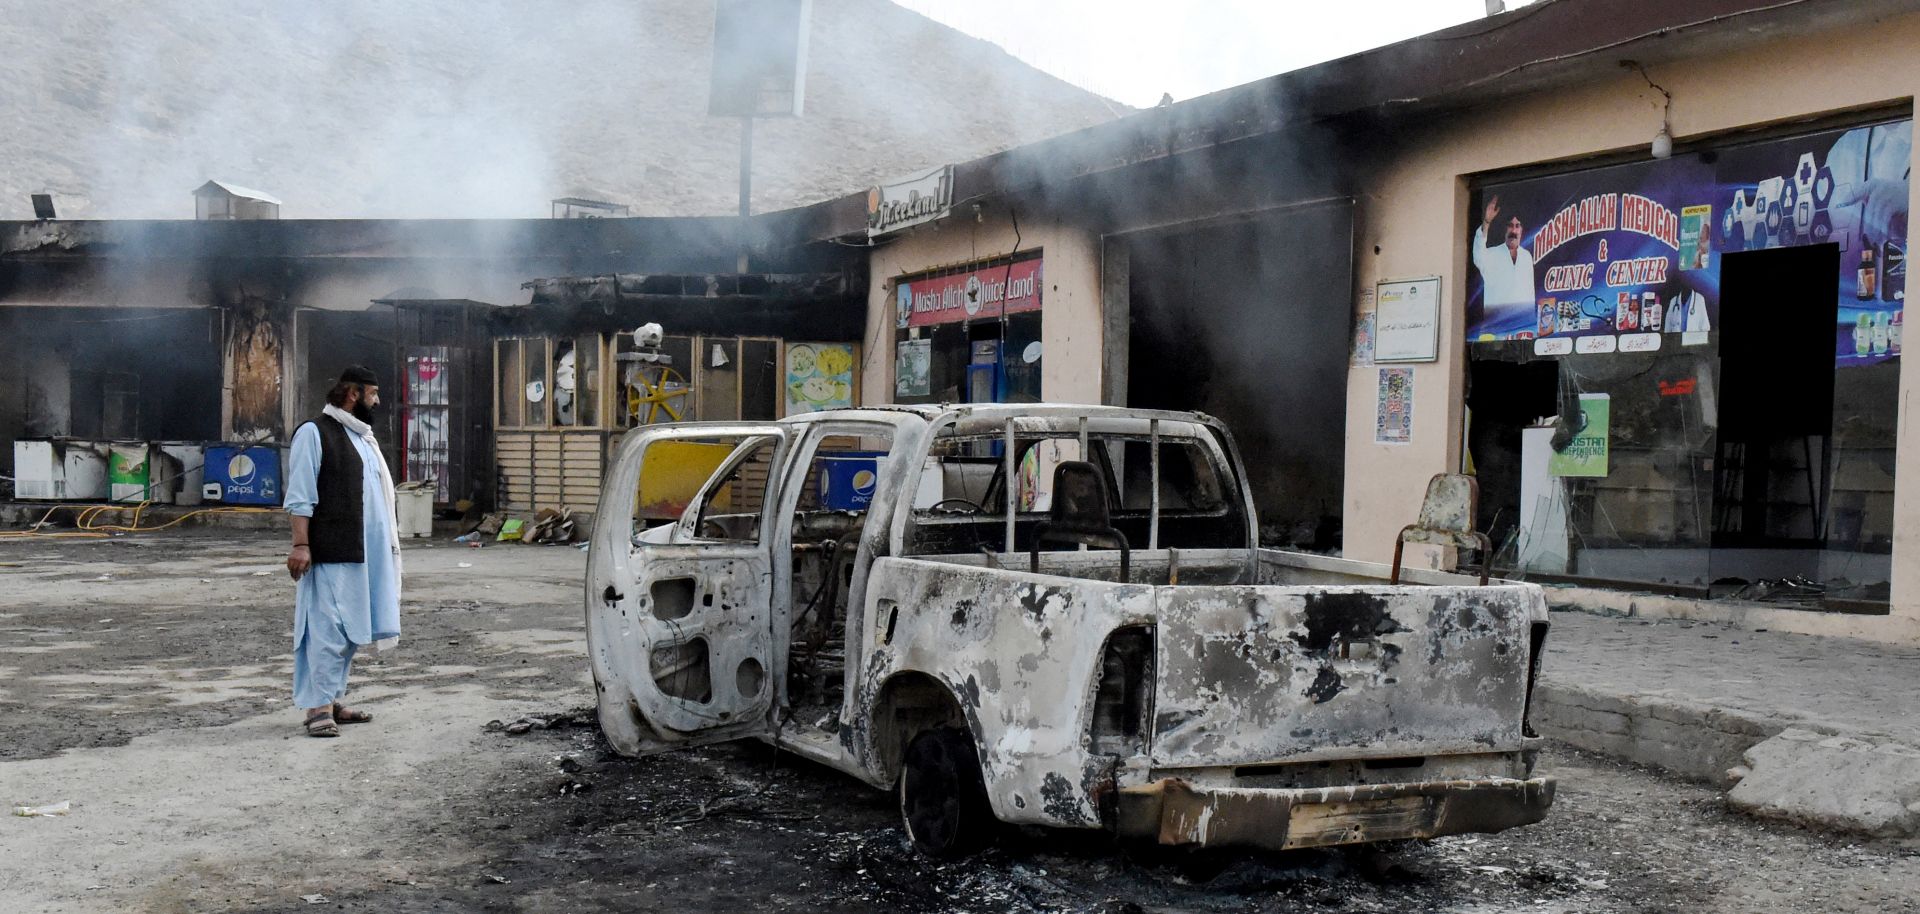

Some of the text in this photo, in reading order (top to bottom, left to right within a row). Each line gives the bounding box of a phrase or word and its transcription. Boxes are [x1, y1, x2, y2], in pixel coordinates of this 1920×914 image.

[1534, 193, 1679, 265] MASHA ALLAH MEDICAL
[1597, 238, 1608, 262] &
[914, 271, 1034, 312] Masha Allah Juice Land
[1545, 257, 1668, 292] CLINIC CENTER
[228, 485, 254, 494] pepsi
